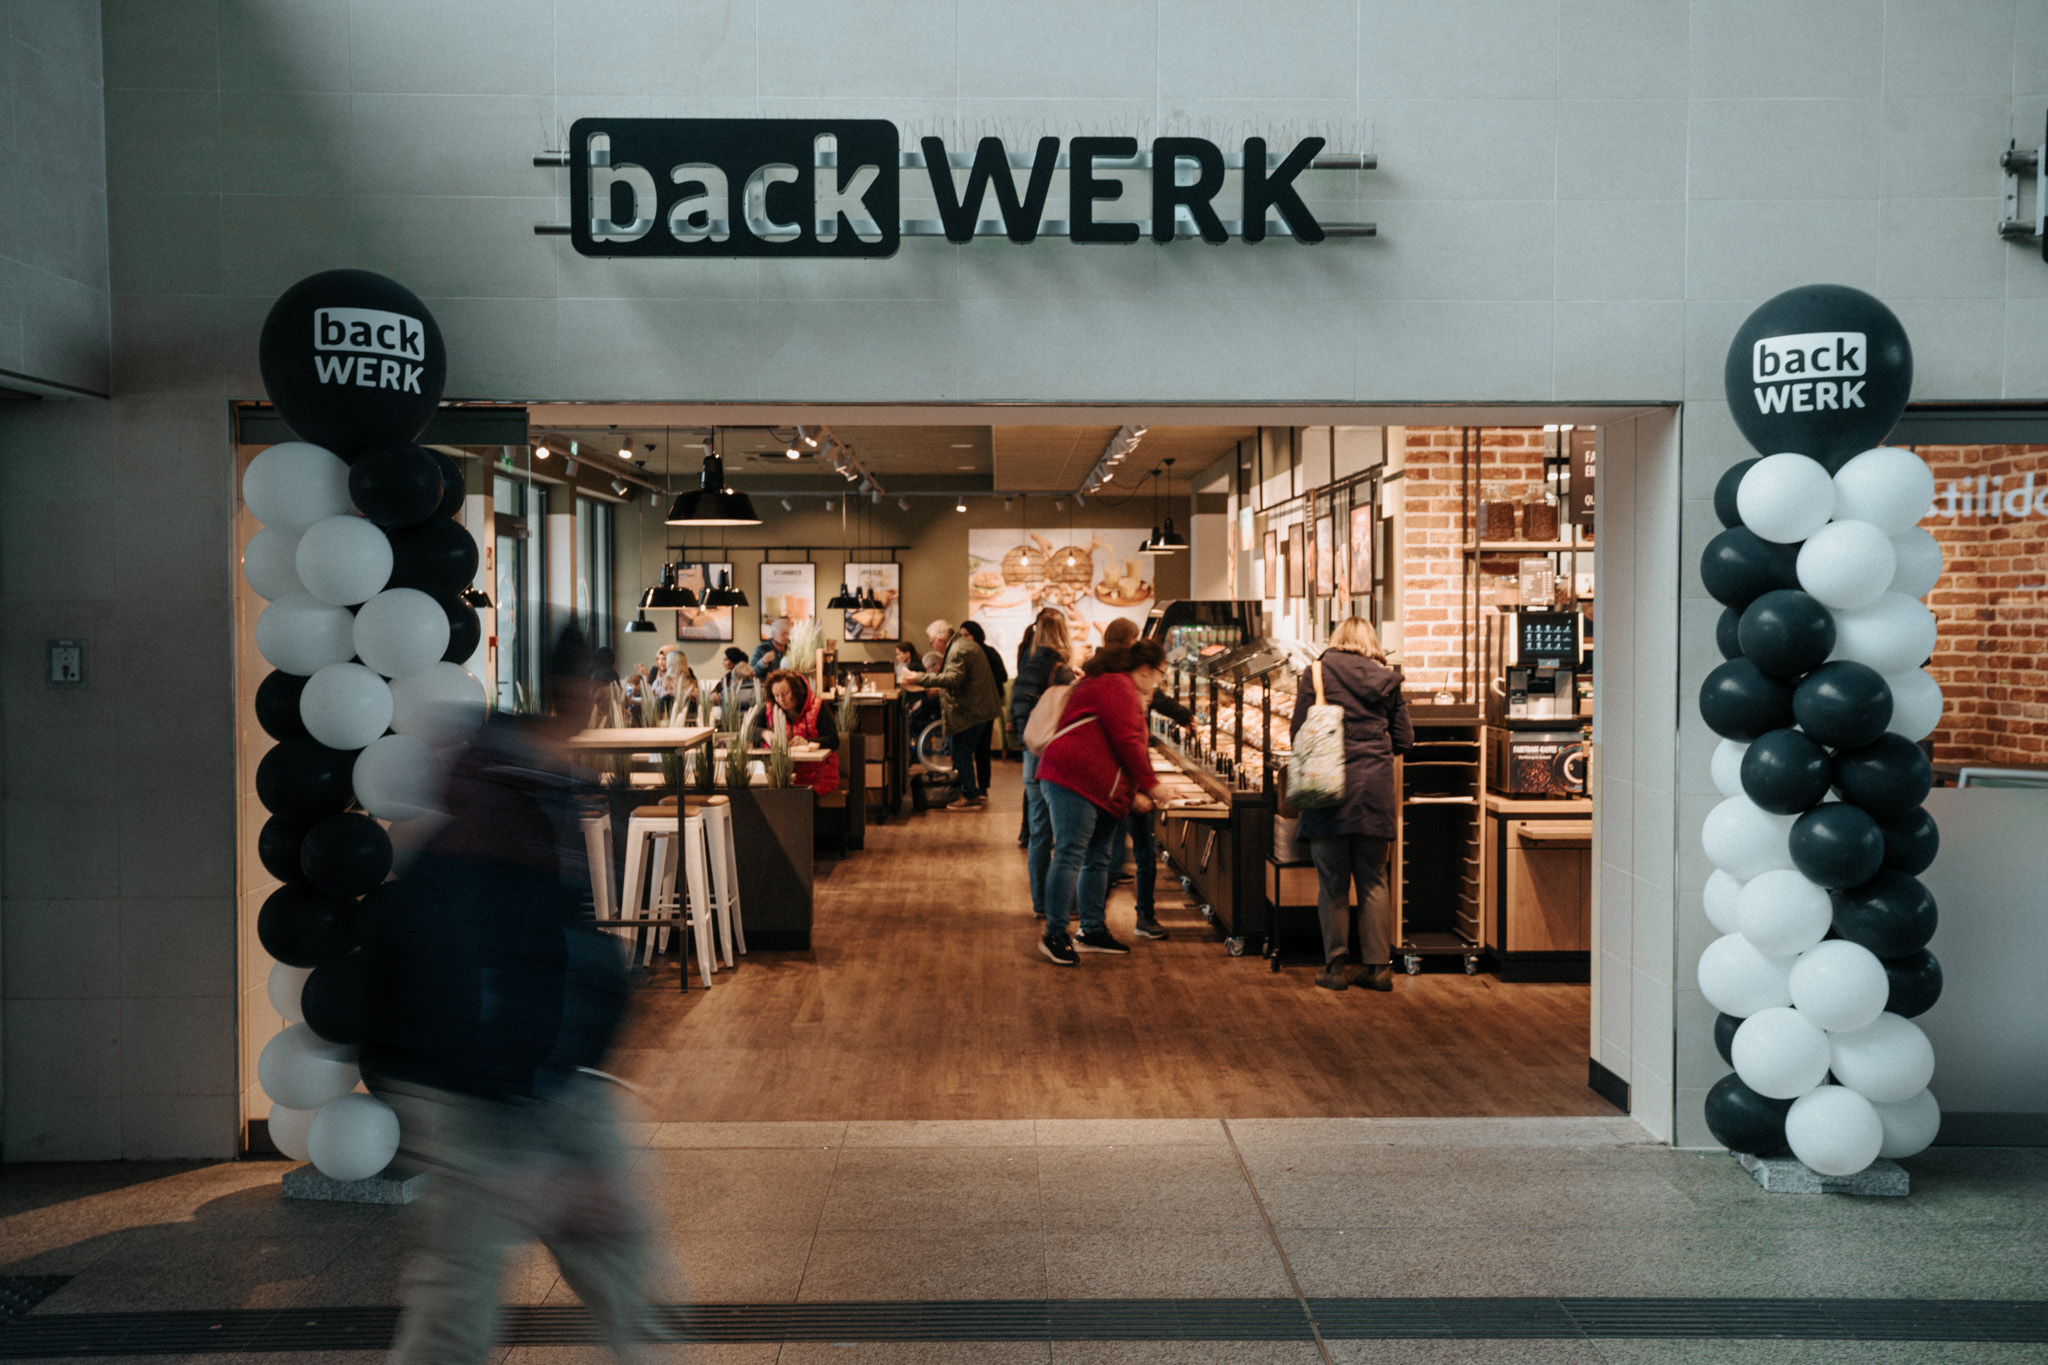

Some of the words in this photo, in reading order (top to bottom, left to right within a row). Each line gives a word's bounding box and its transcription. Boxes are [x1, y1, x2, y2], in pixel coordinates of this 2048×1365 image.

[588, 131, 883, 243] back
[920, 135, 1326, 244] WERK
[320, 312, 419, 355] back
[314, 355, 424, 394] WERK
[1759, 337, 1859, 377] back
[1754, 380, 1866, 414] WERK
